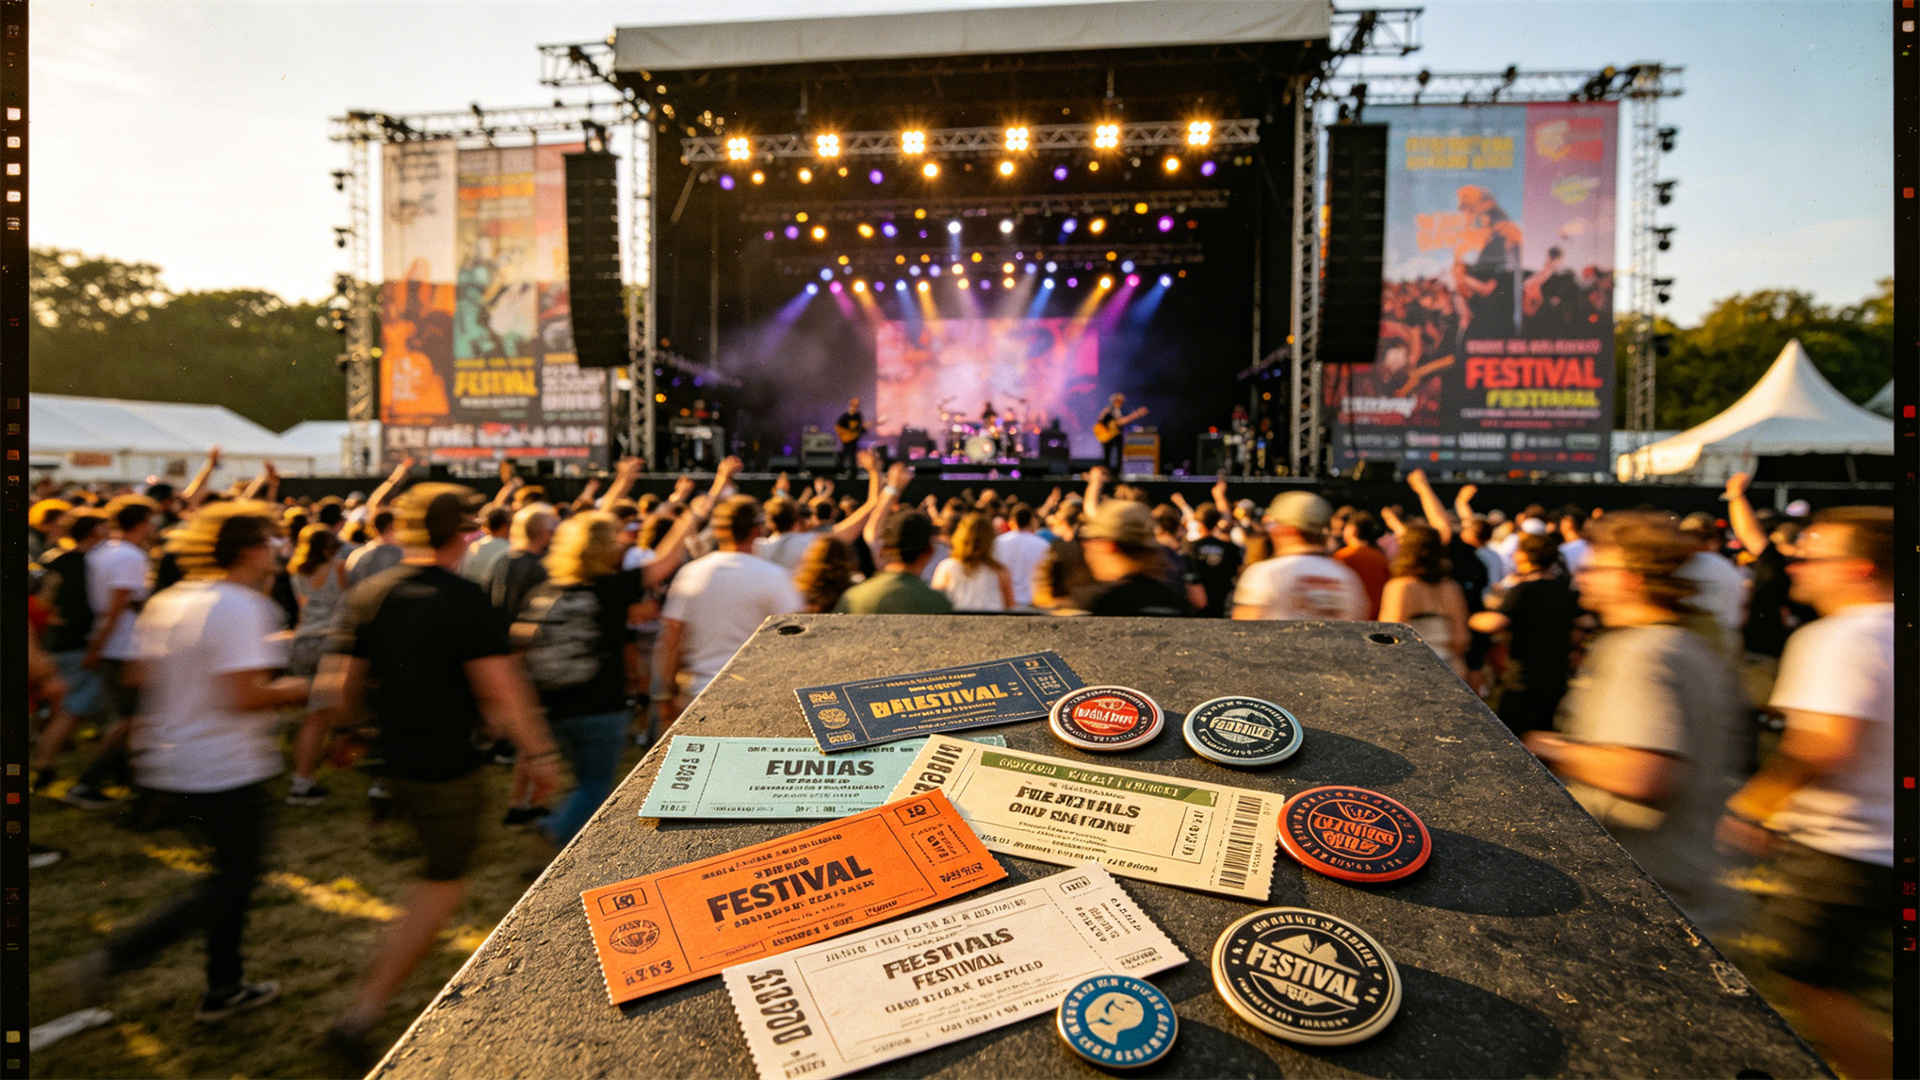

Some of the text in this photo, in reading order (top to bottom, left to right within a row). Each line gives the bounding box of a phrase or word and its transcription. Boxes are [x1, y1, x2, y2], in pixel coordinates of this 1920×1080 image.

[1465, 356, 1603, 389] FESTIVAL
[766, 760, 874, 776] EUNIAS
[707, 855, 873, 923] FESTIVAL
[1246, 942, 1360, 1004] FESTIVAL
